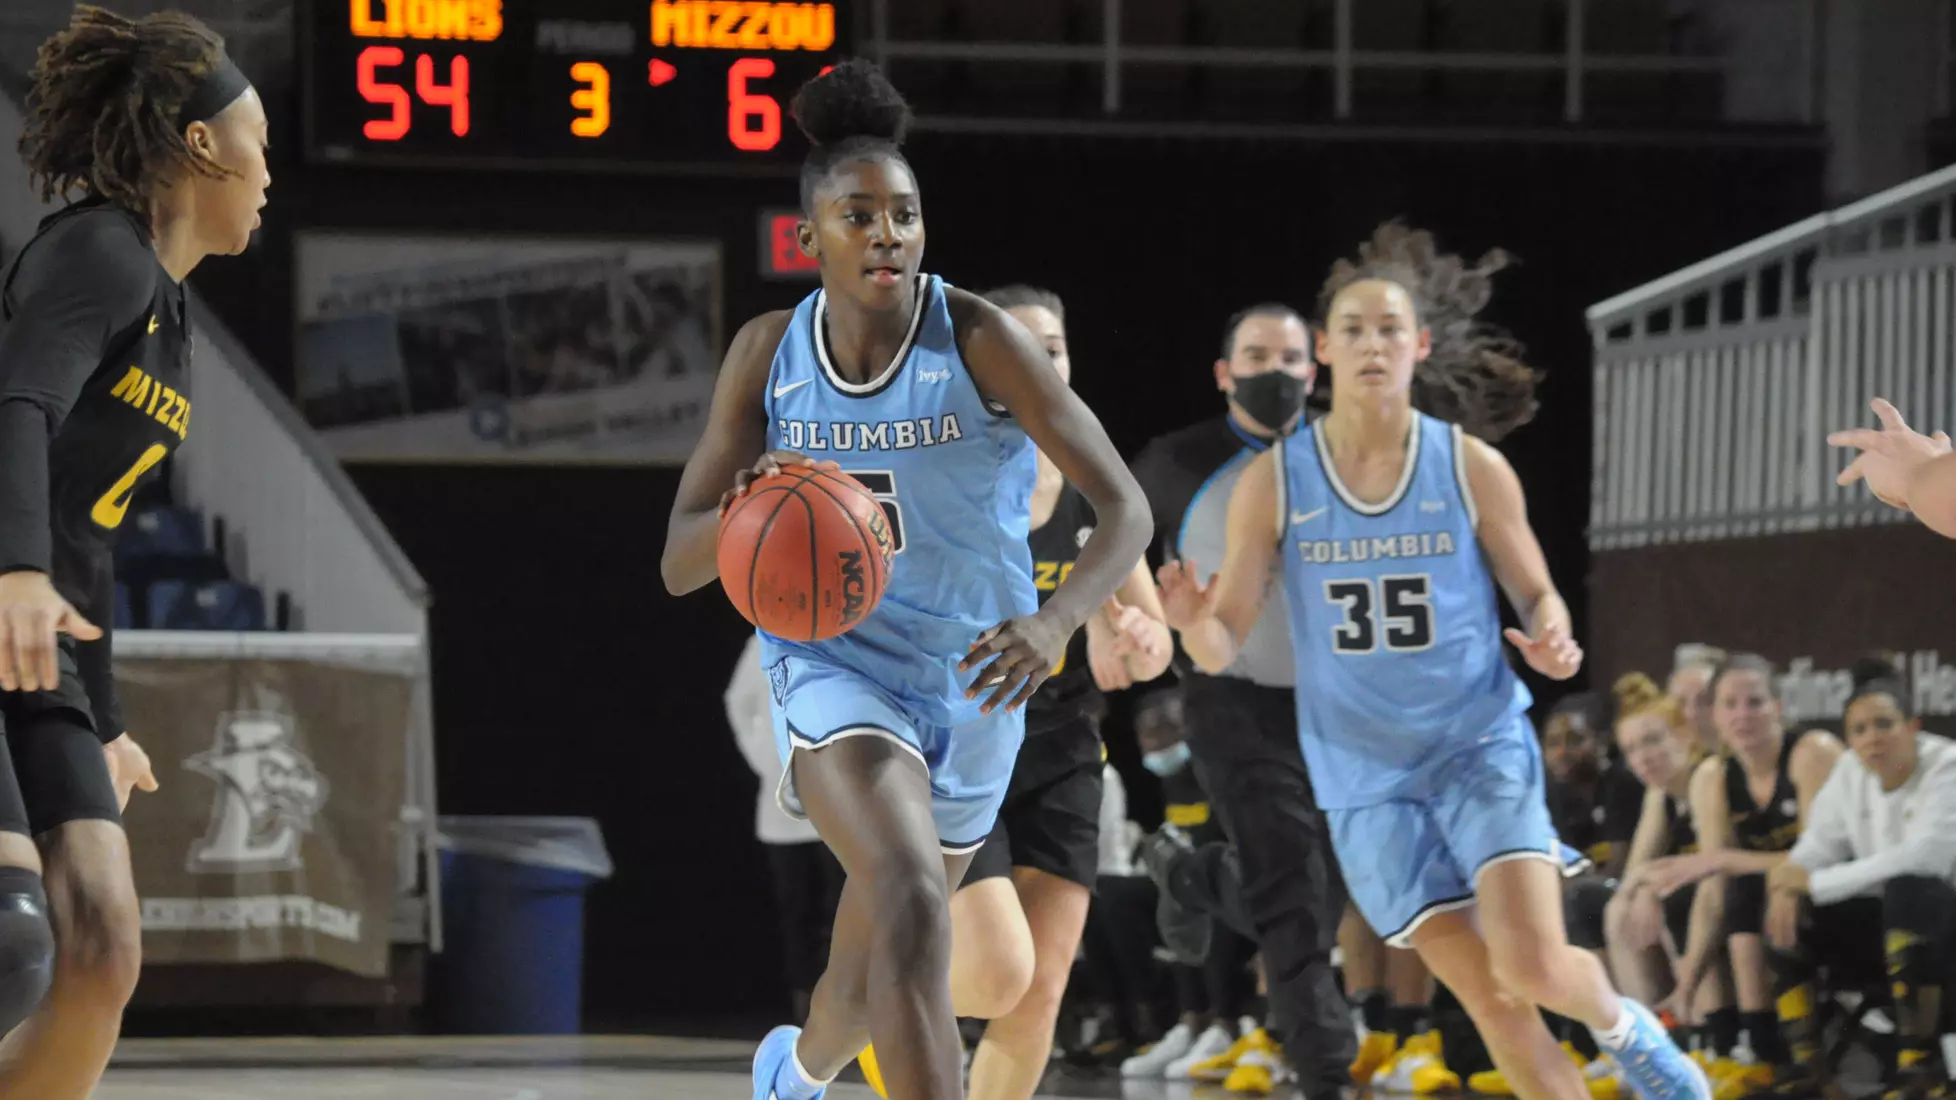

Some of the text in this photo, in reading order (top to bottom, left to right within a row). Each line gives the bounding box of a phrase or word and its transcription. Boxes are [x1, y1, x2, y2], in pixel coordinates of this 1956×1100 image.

[650, 0, 836, 51] MIZZOU
[356, 45, 470, 141] 54
[569, 62, 611, 137] 3
[778, 412, 963, 451] COLUMBIA
[1297, 531, 1456, 563] COLUMBIA
[1322, 573, 1436, 654] 35
